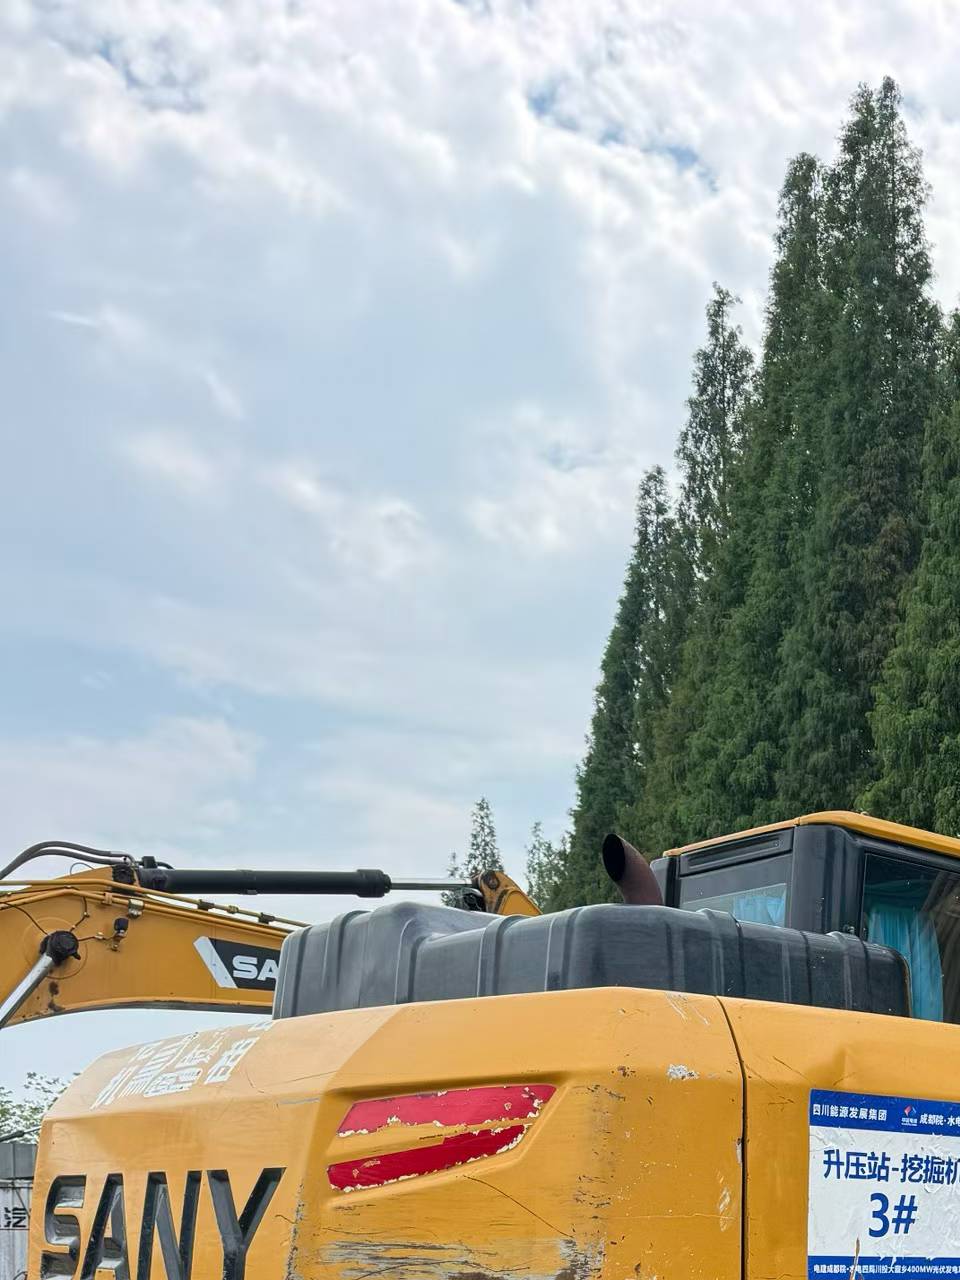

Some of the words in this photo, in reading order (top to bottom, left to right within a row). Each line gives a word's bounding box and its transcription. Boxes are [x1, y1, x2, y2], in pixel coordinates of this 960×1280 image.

[232, 955, 280, 981] SA
[812, 1104, 888, 1121] 四川能源发展集团
[868, 1193, 918, 1237] 3#
